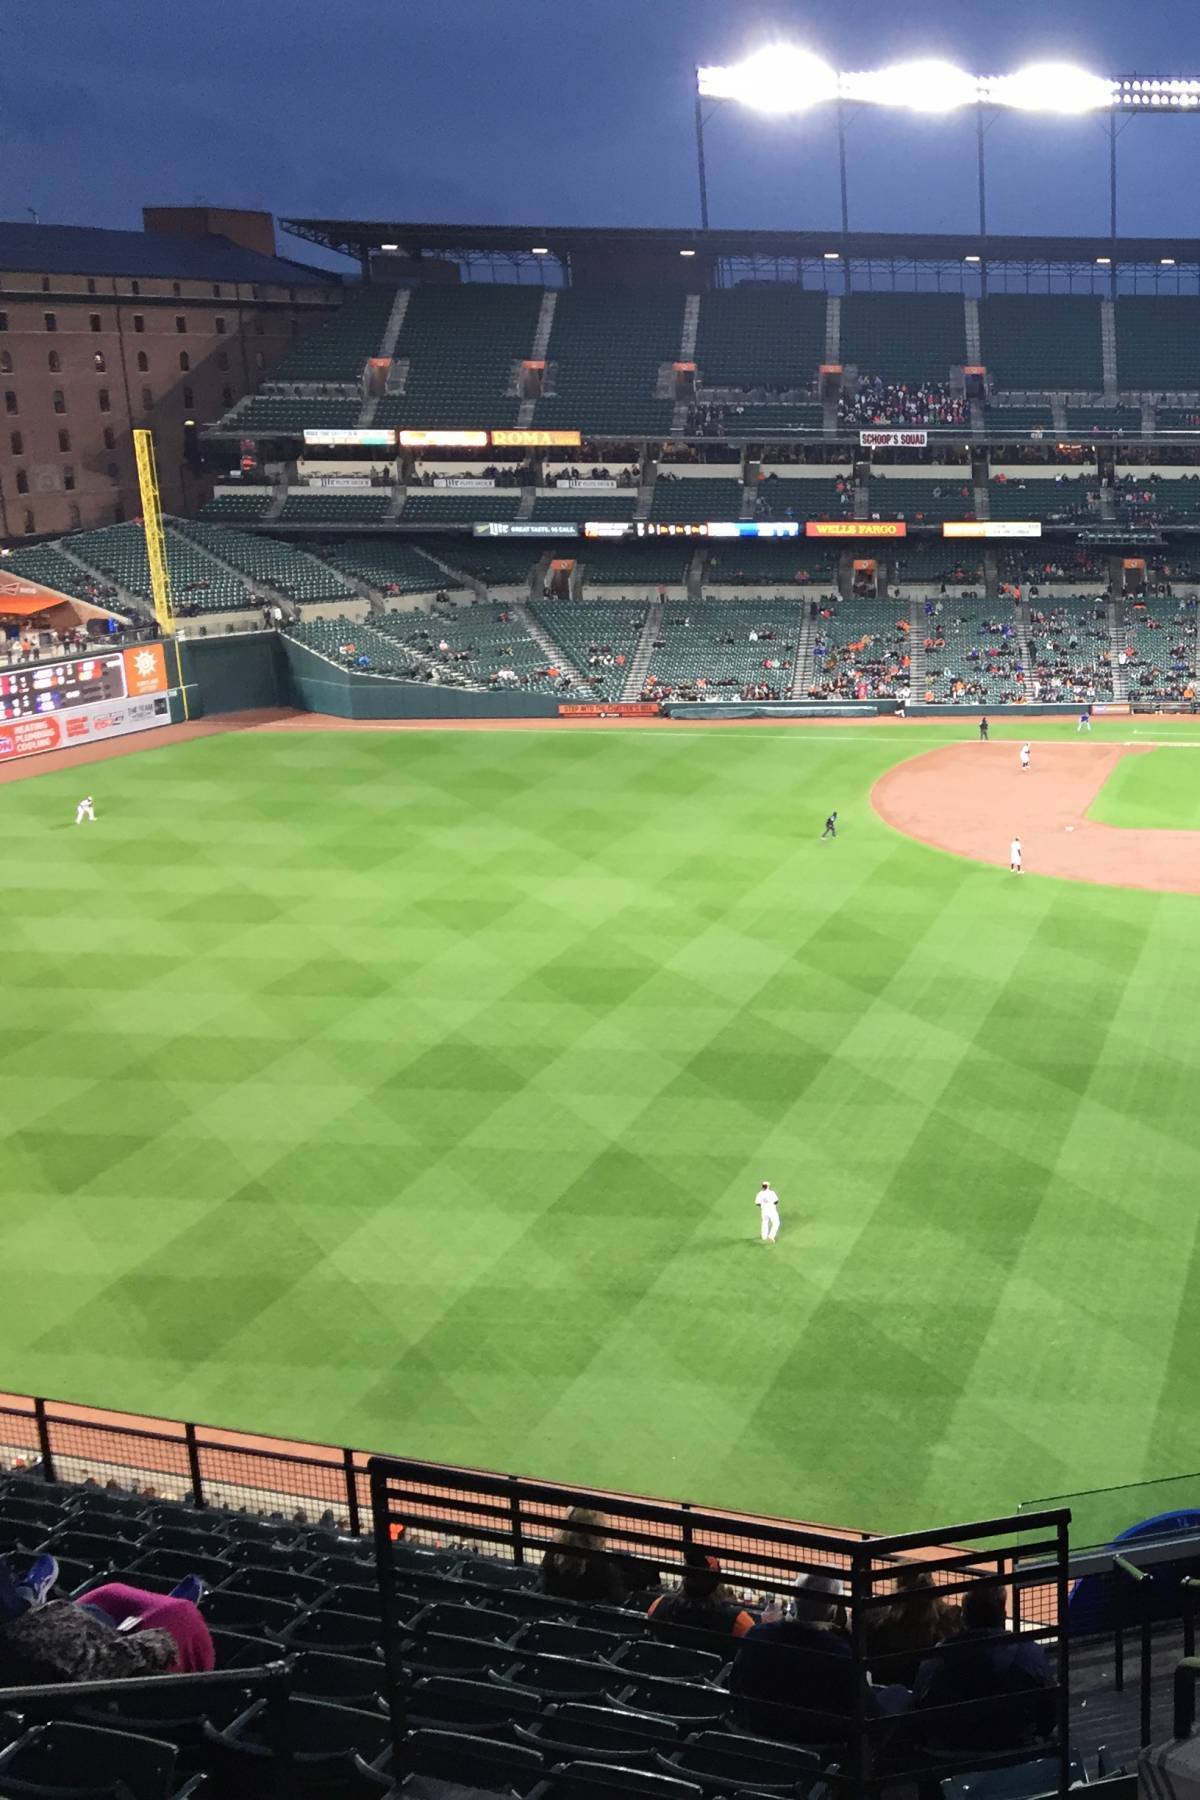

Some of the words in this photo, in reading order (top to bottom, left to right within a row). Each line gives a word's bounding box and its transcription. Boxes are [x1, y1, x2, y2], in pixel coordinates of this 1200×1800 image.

[494, 431, 552, 446] ROMA
[862, 433, 899, 445] SCHOOP'S
[900, 433, 925, 445] SQUAD
[816, 524, 857, 535] WELLS
[859, 524, 897, 535] FARGO
